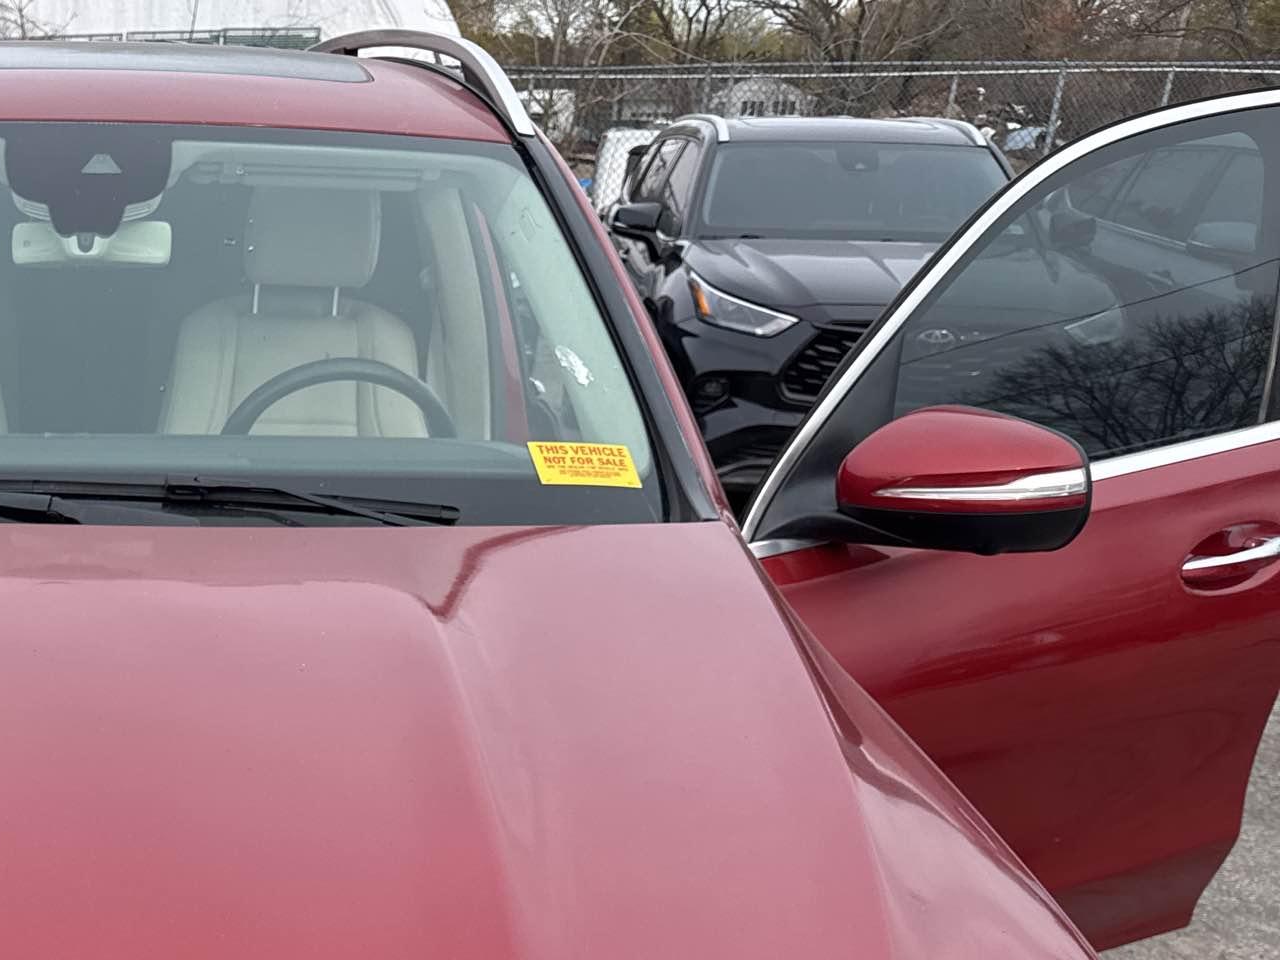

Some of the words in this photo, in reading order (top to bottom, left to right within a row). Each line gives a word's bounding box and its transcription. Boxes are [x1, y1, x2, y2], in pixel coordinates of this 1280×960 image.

[536, 445, 568, 455] THIS
[570, 446, 627, 457] VEHICLE
[543, 456, 567, 465] NOT
[570, 457, 594, 465] FOR
[598, 457, 627, 467] SALE
